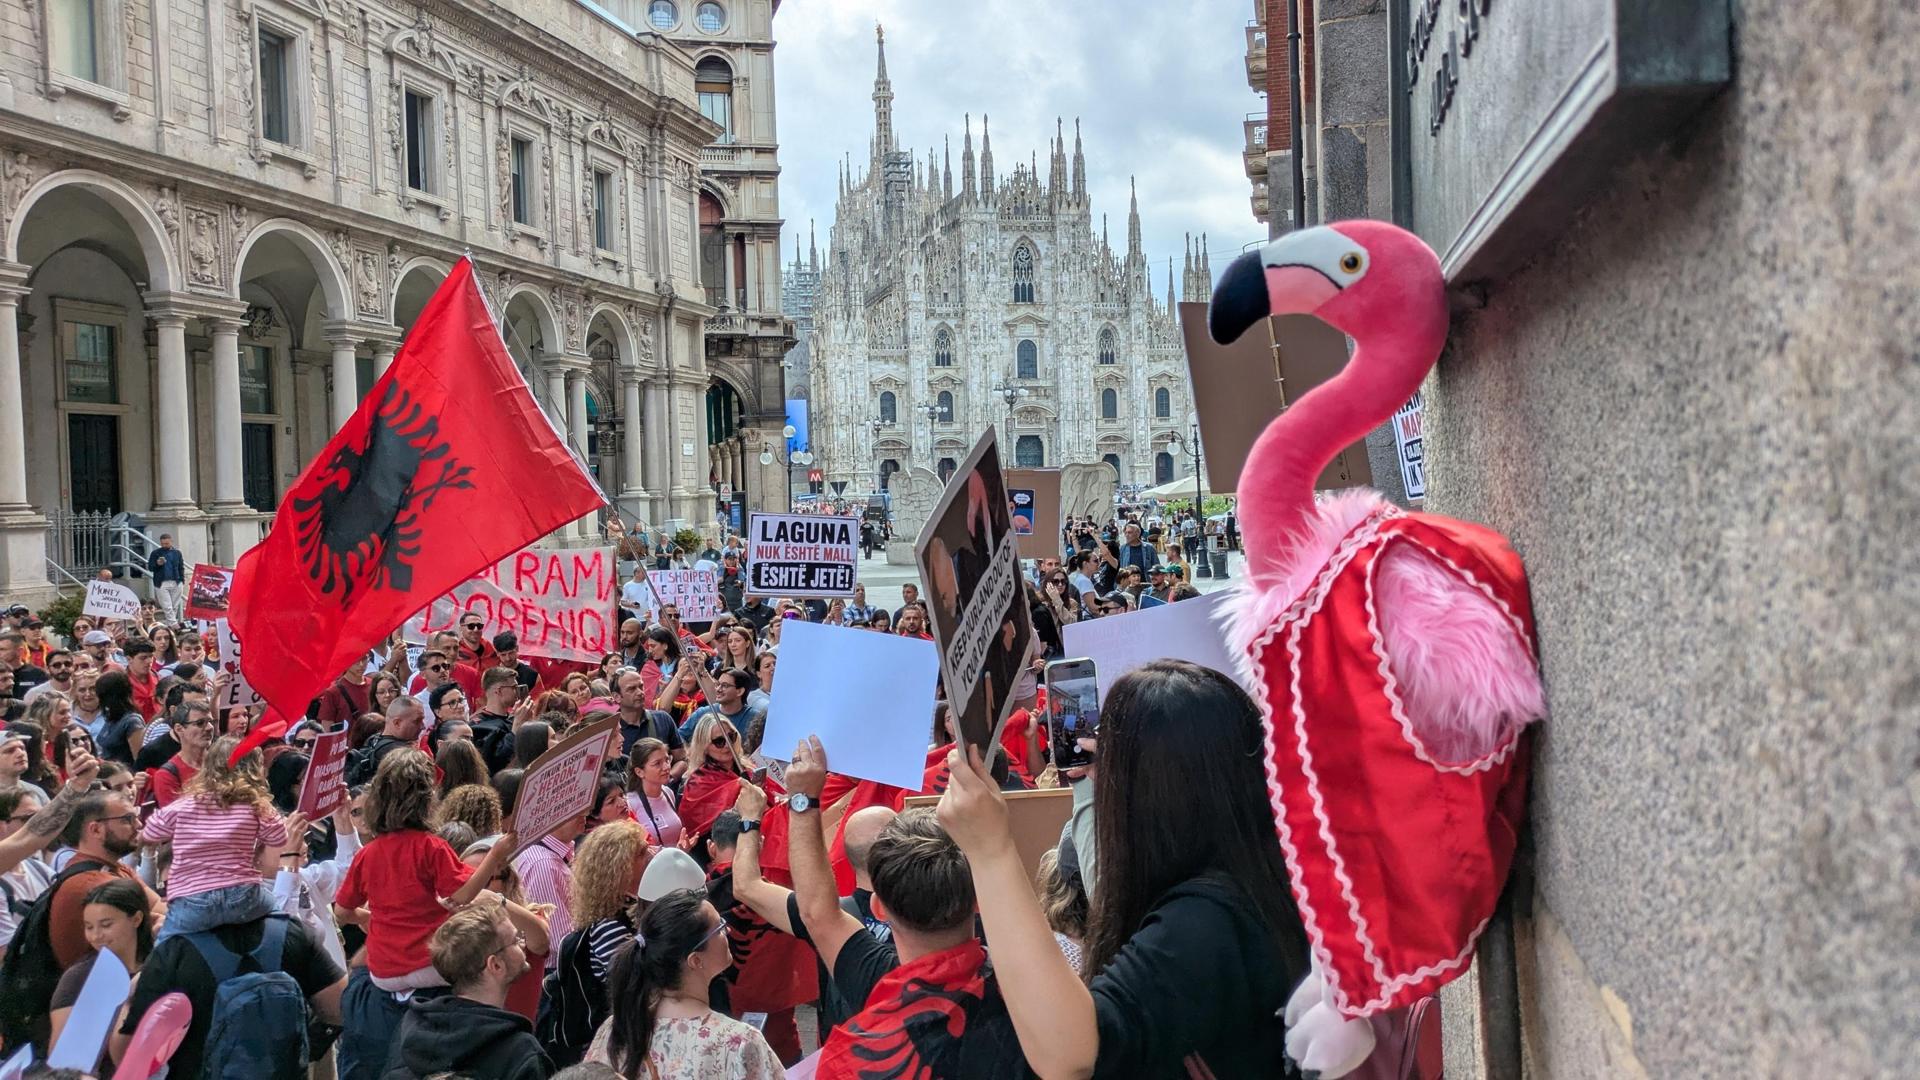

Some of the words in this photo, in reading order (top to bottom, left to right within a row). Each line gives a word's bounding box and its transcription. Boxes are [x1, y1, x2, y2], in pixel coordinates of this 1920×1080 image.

[810, 472, 822, 482] M
[761, 520, 851, 545] LAGUNA
[756, 545, 780, 560] NUK
[784, 544, 820, 560] ËSHTË
[760, 563, 807, 587] ËSHTË
[810, 565, 850, 588] JETË!
[91, 584, 120, 597] MONEY
[90, 600, 111, 609] WRITE
[949, 633, 968, 675] KEEP
[965, 606, 979, 641] OUR
[976, 575, 994, 615] LAND
[992, 554, 1005, 584] OUT
[961, 647, 979, 691] YOUR
[976, 610, 994, 657] DIRTY
[993, 574, 1012, 622] HANDS
